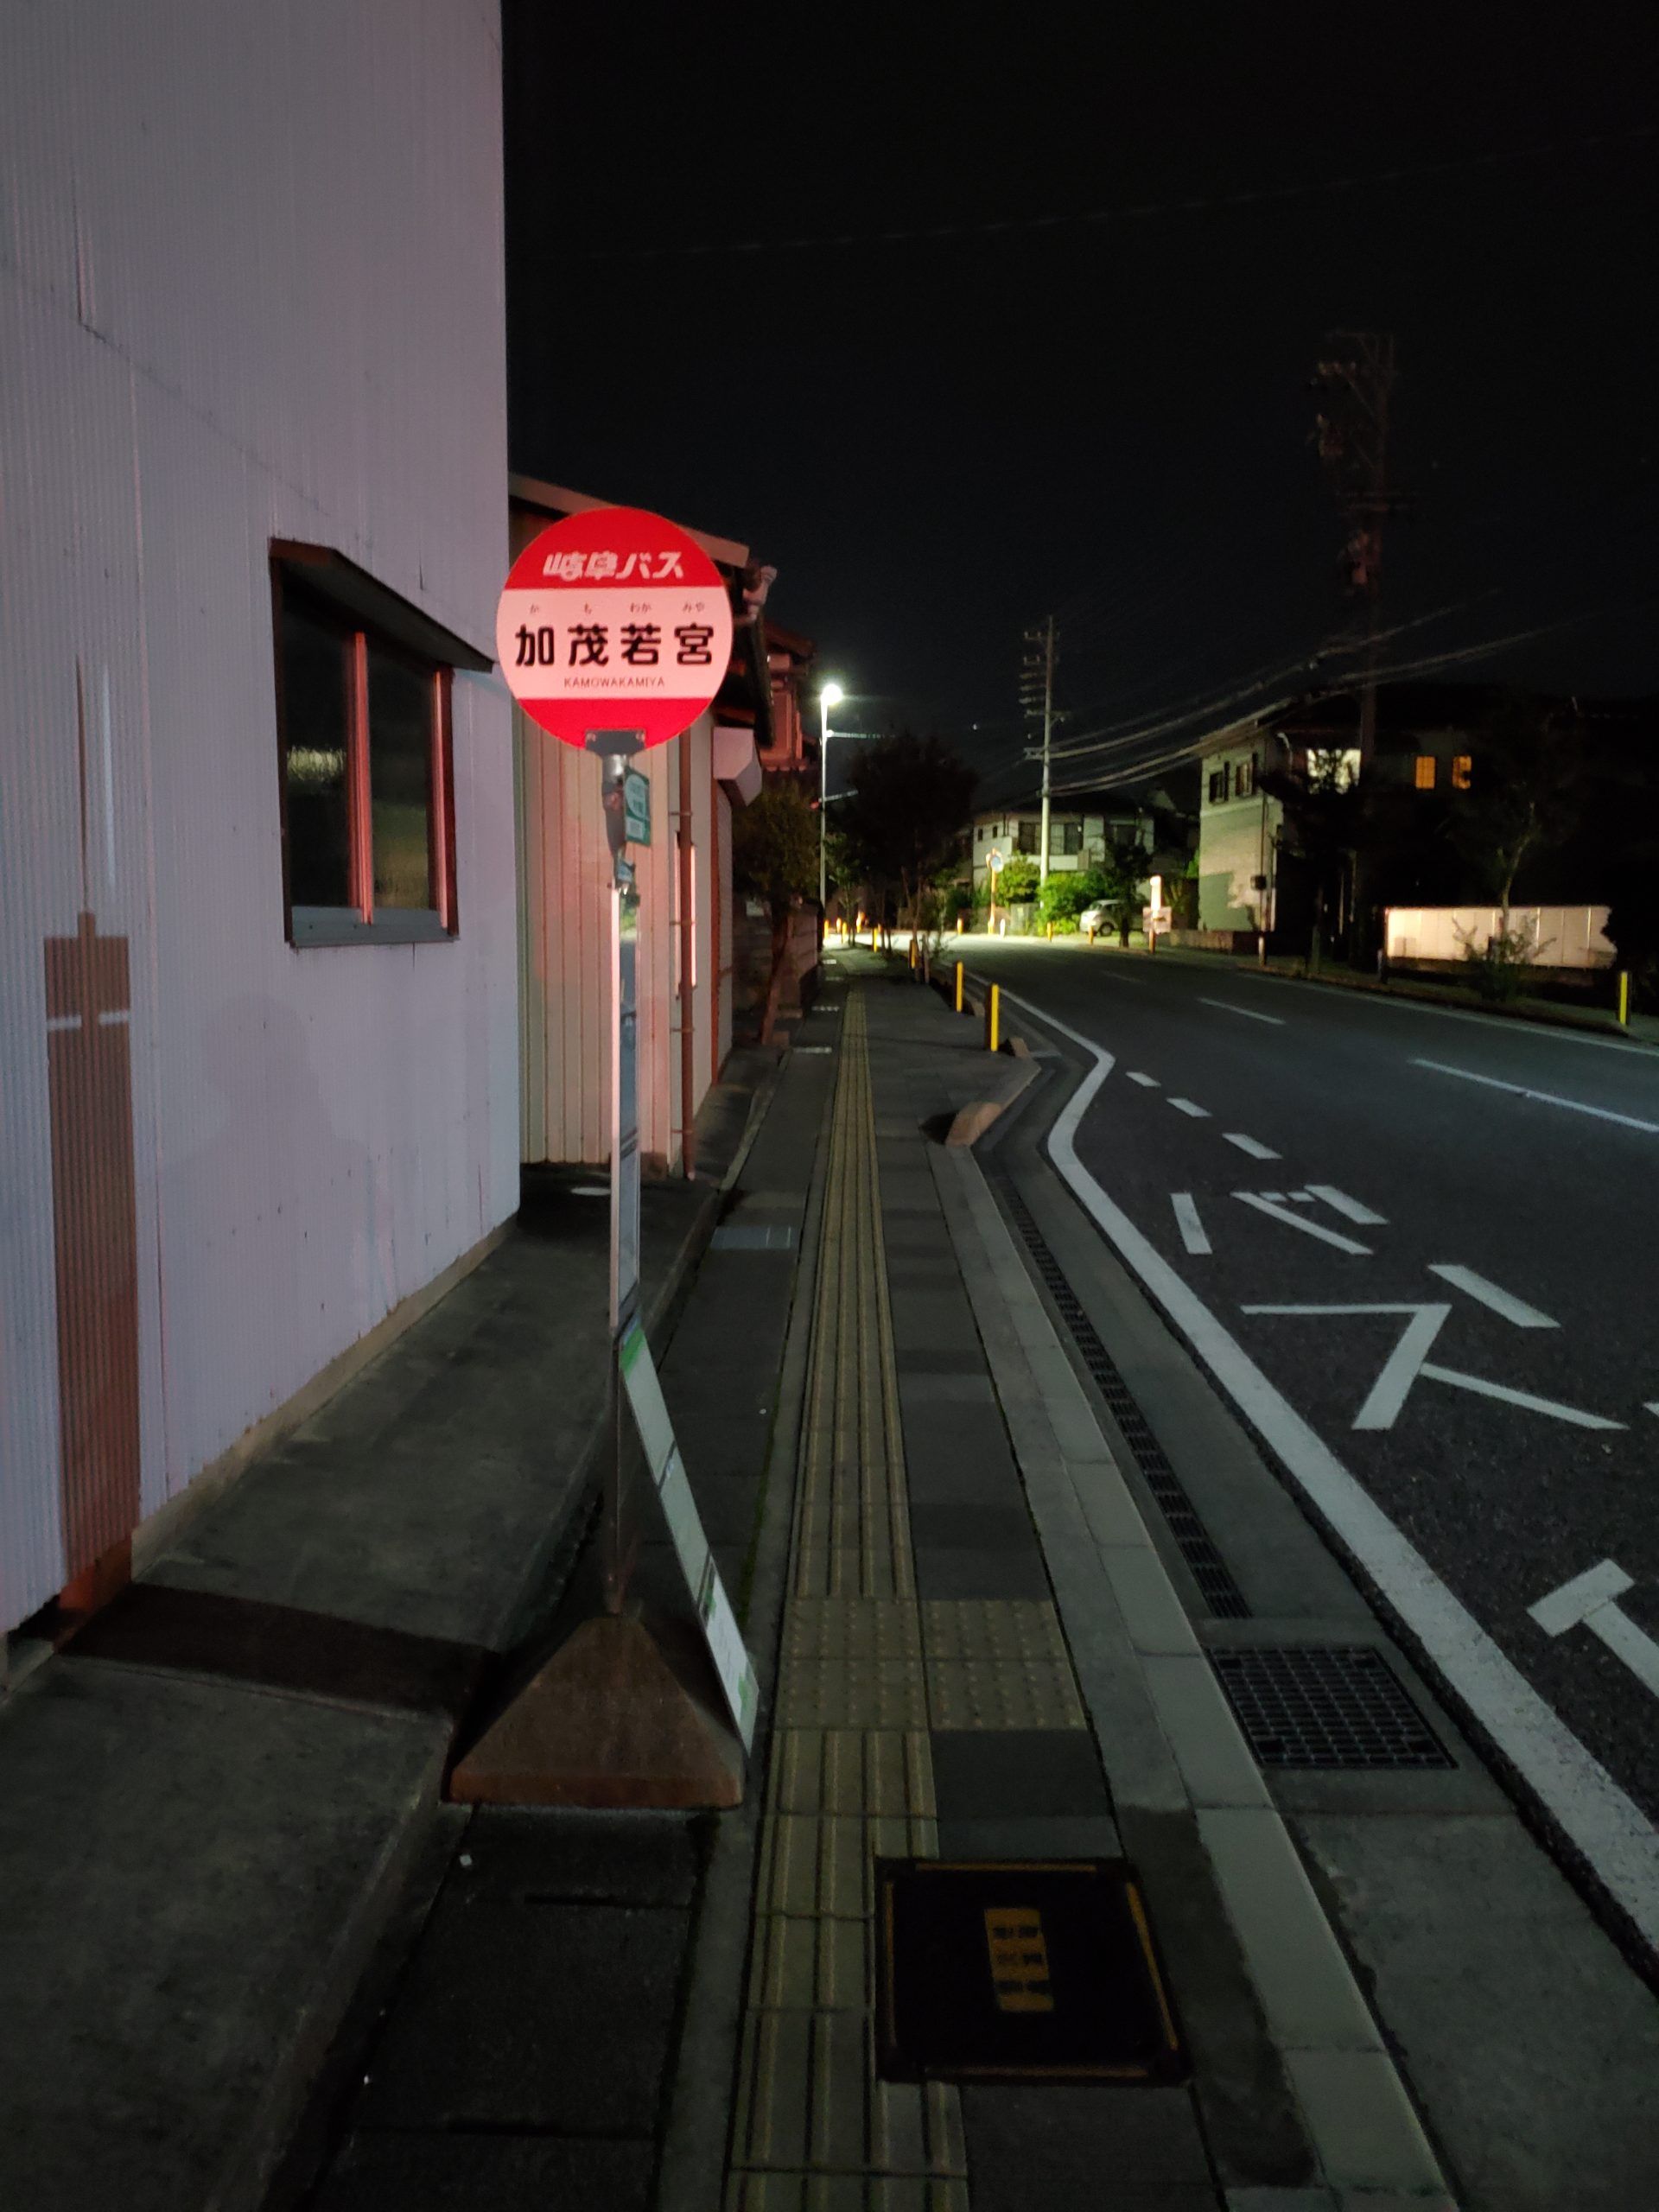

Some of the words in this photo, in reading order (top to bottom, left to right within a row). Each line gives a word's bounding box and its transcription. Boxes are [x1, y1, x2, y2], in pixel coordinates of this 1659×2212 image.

[543, 550, 684, 582] 岐阜バス
[515, 622, 715, 667] 加茂若宮
[564, 677, 665, 689] KAMOWAKAMIYA
